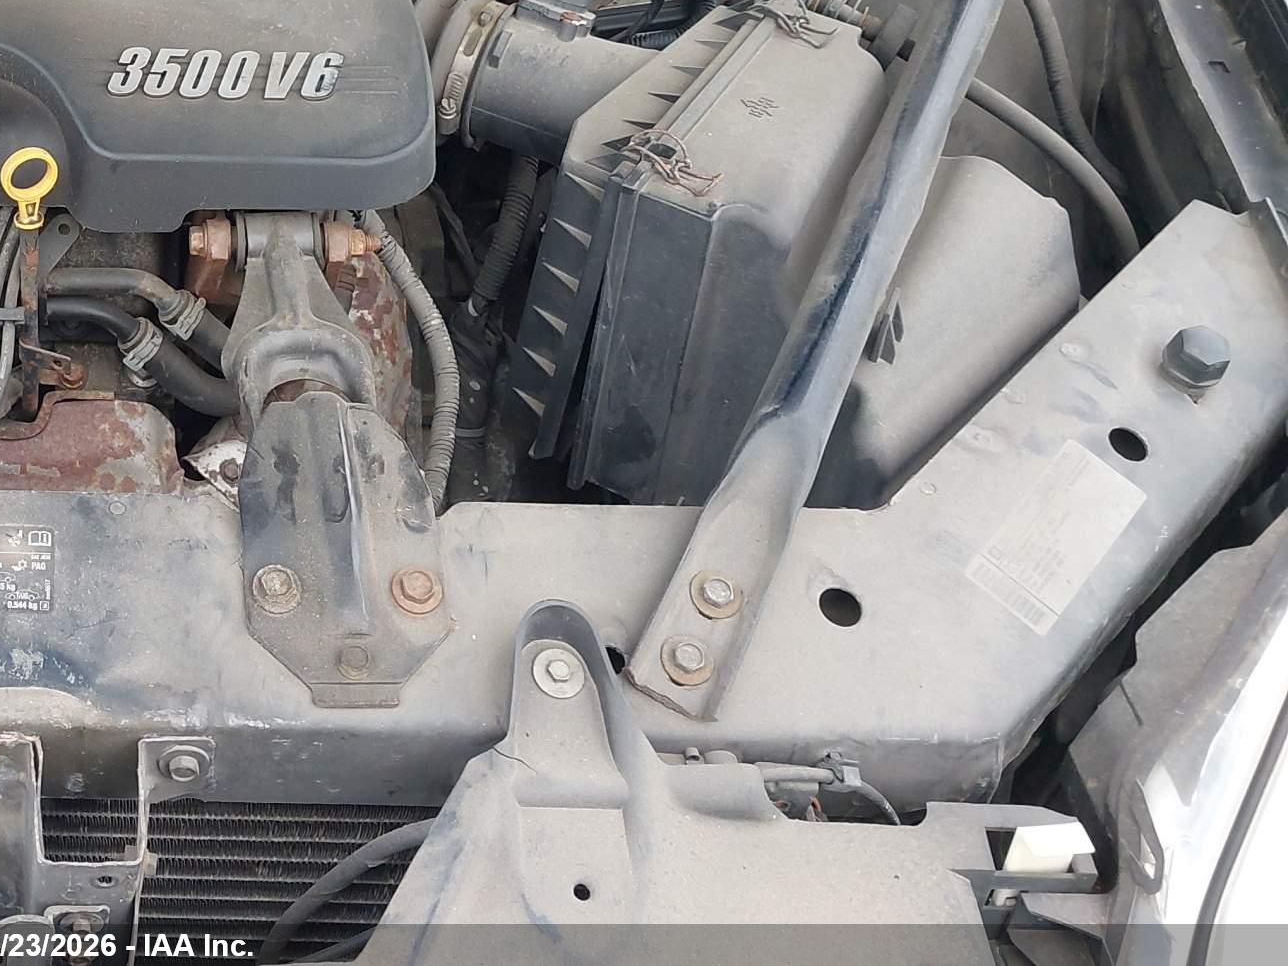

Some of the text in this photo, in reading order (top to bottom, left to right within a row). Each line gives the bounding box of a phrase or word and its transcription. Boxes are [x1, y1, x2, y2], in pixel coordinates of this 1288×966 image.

[106, 46, 345, 101] 3500 V6
[5, 582, 16, 591] kg
[6, 600, 38, 610] 0.544 kg
